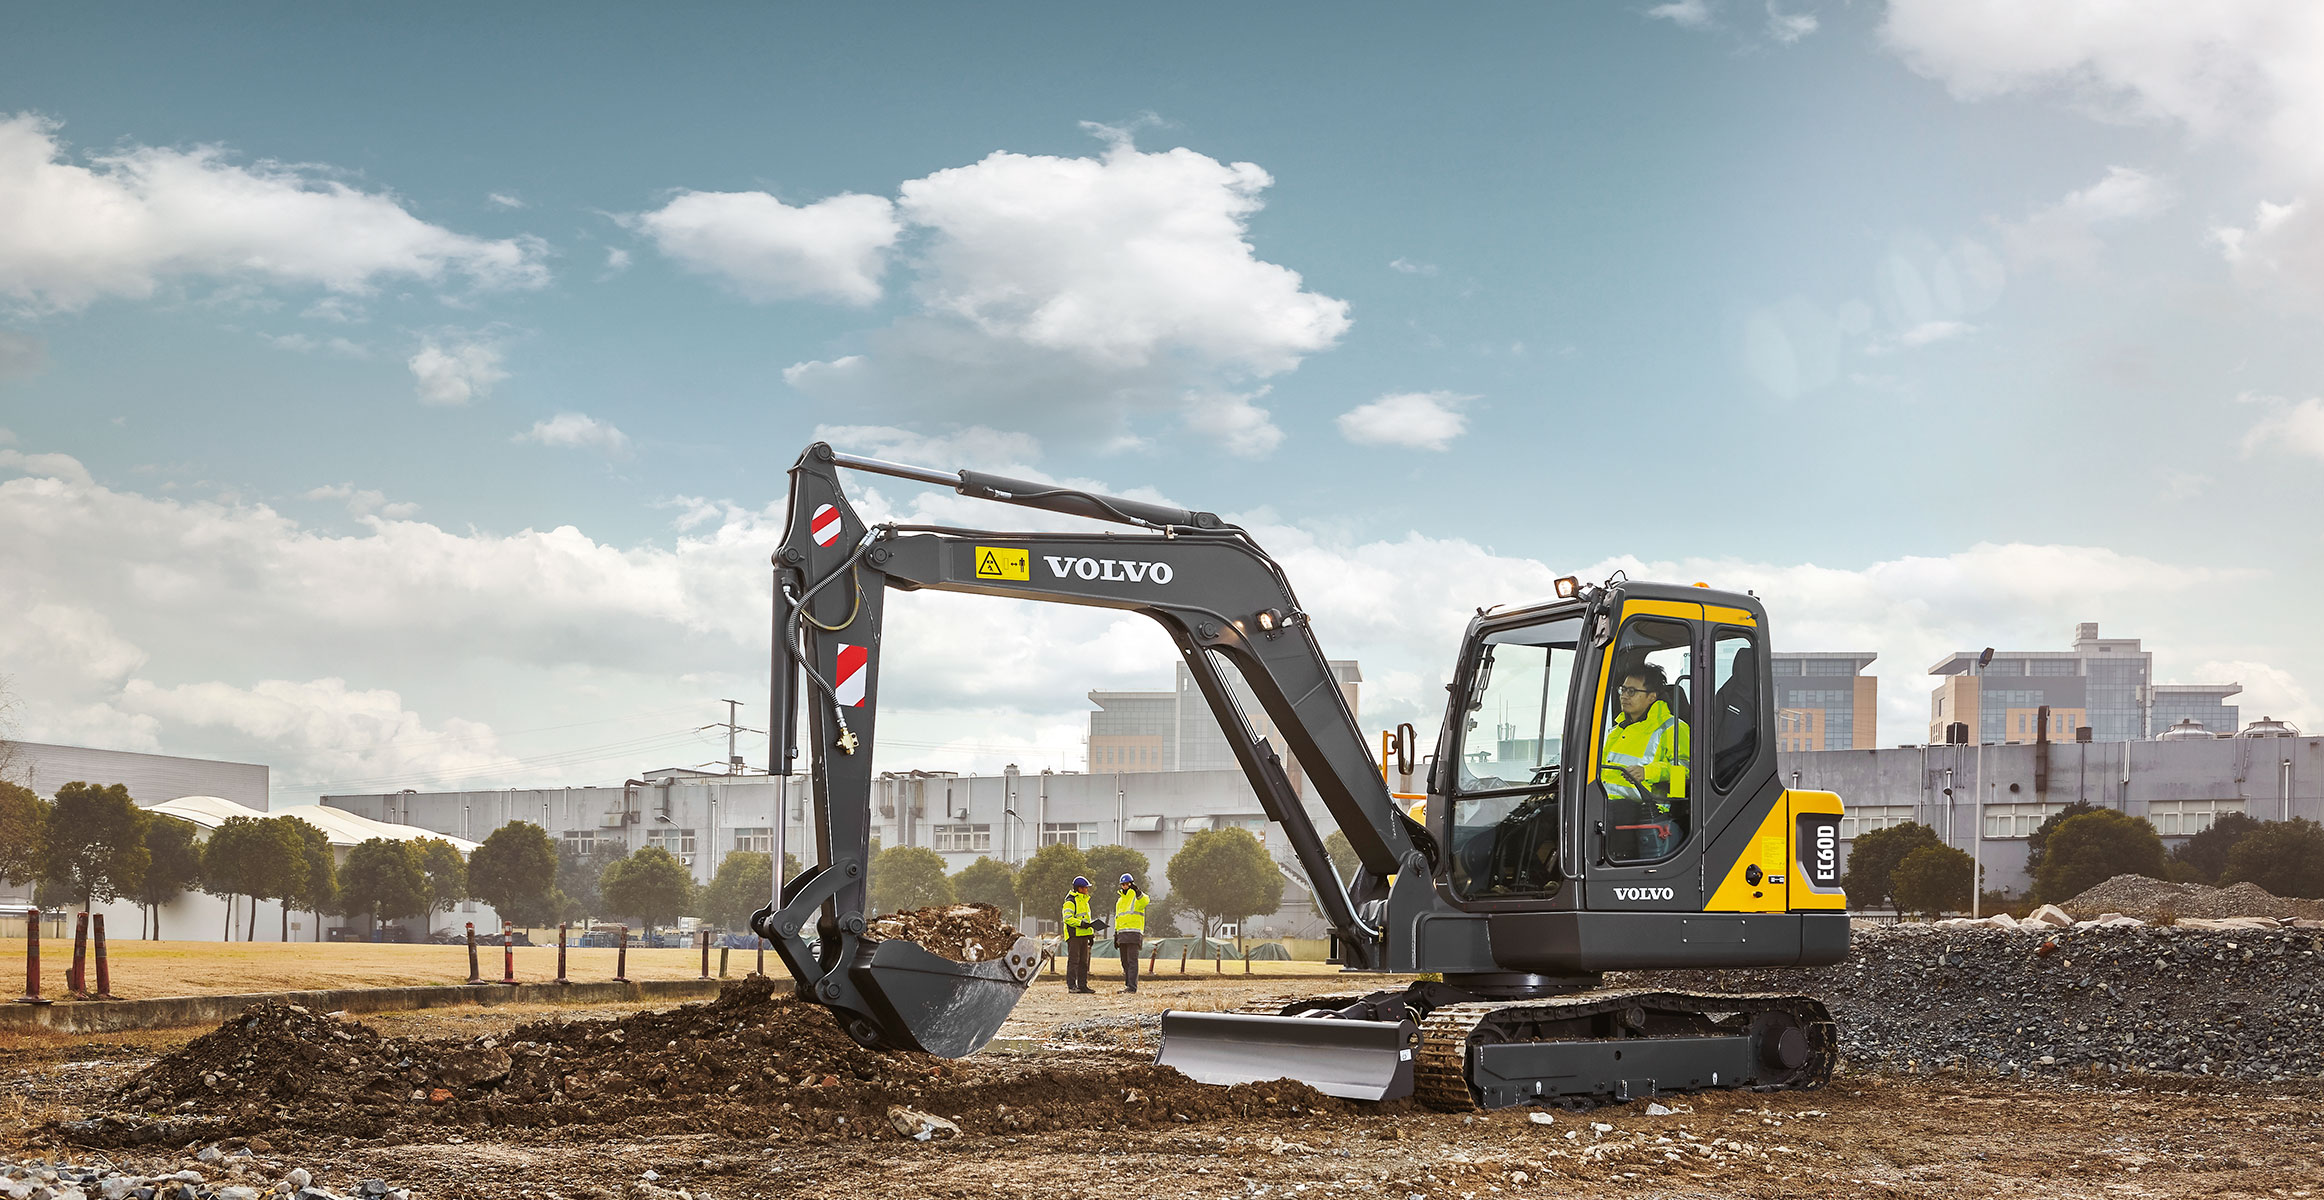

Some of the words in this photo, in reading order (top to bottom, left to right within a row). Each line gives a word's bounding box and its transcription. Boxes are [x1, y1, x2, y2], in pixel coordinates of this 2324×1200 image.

[1043, 555, 1174, 585] VOLVO
[1817, 825, 1835, 880] EC60D
[1613, 887, 1674, 901] VOLVO
